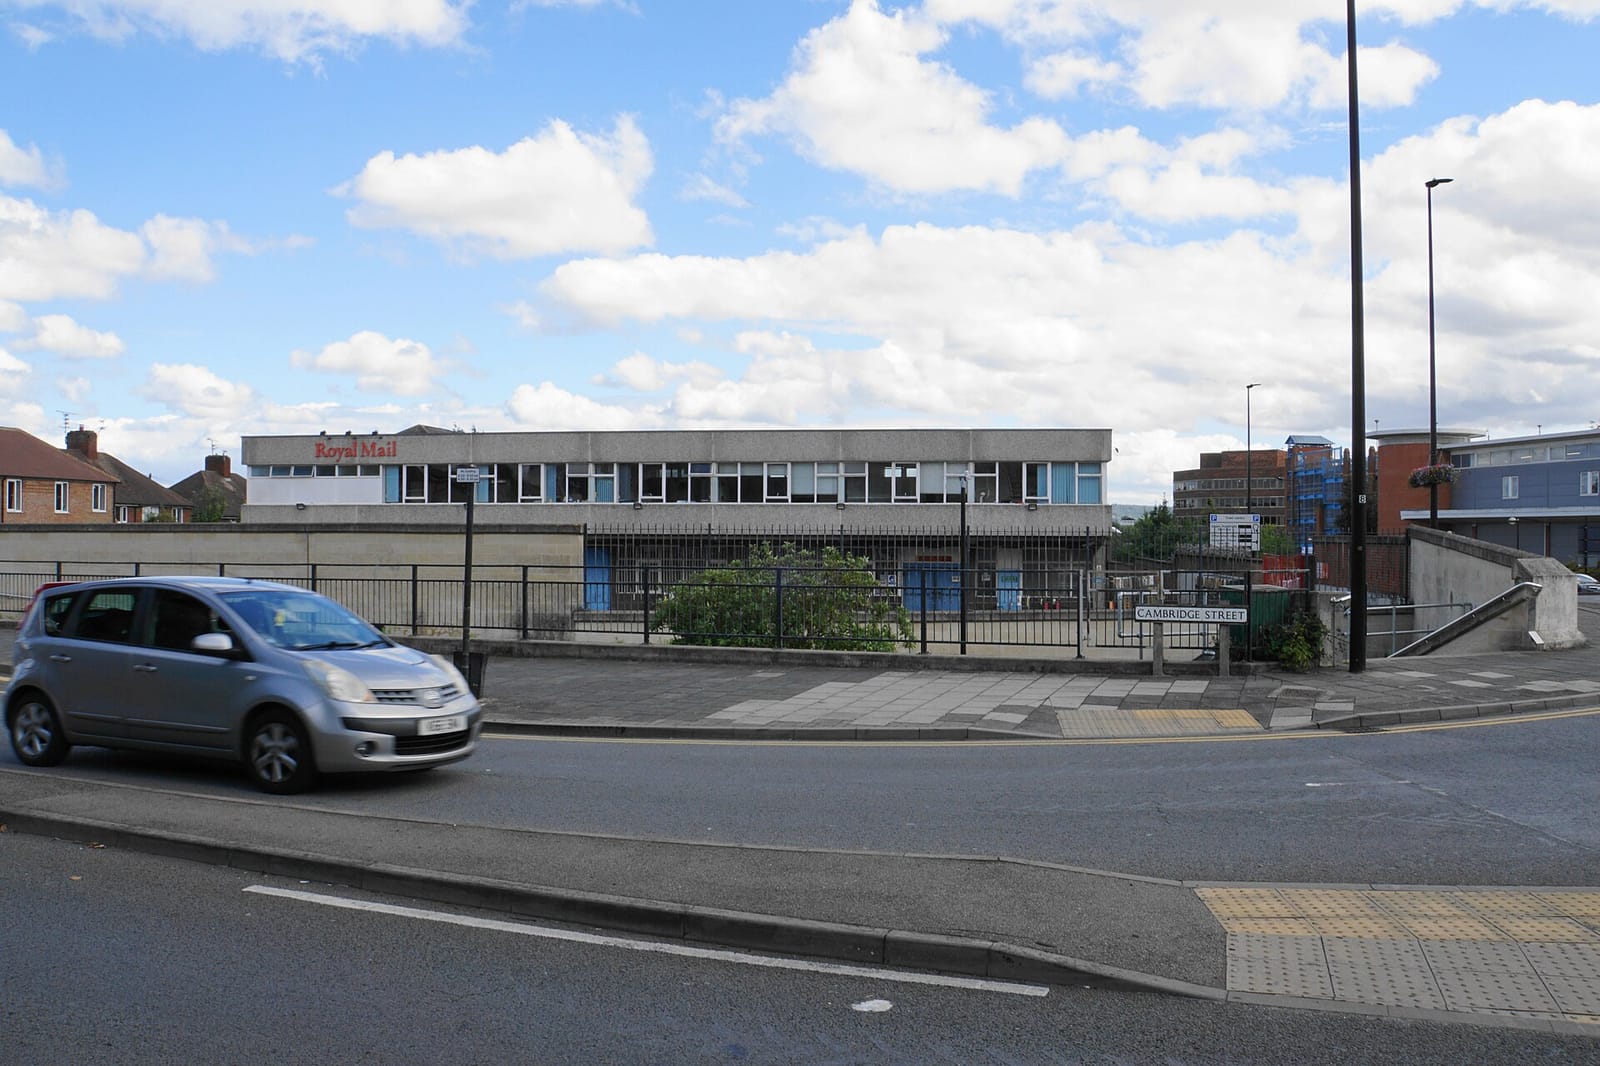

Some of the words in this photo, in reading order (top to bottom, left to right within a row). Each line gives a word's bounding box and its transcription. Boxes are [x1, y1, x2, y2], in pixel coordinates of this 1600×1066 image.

[314, 440, 358, 463] Royal
[360, 440, 396, 458] Mail
[1136, 608, 1201, 619] CAMBRIDGE
[1204, 610, 1246, 620] STREET
